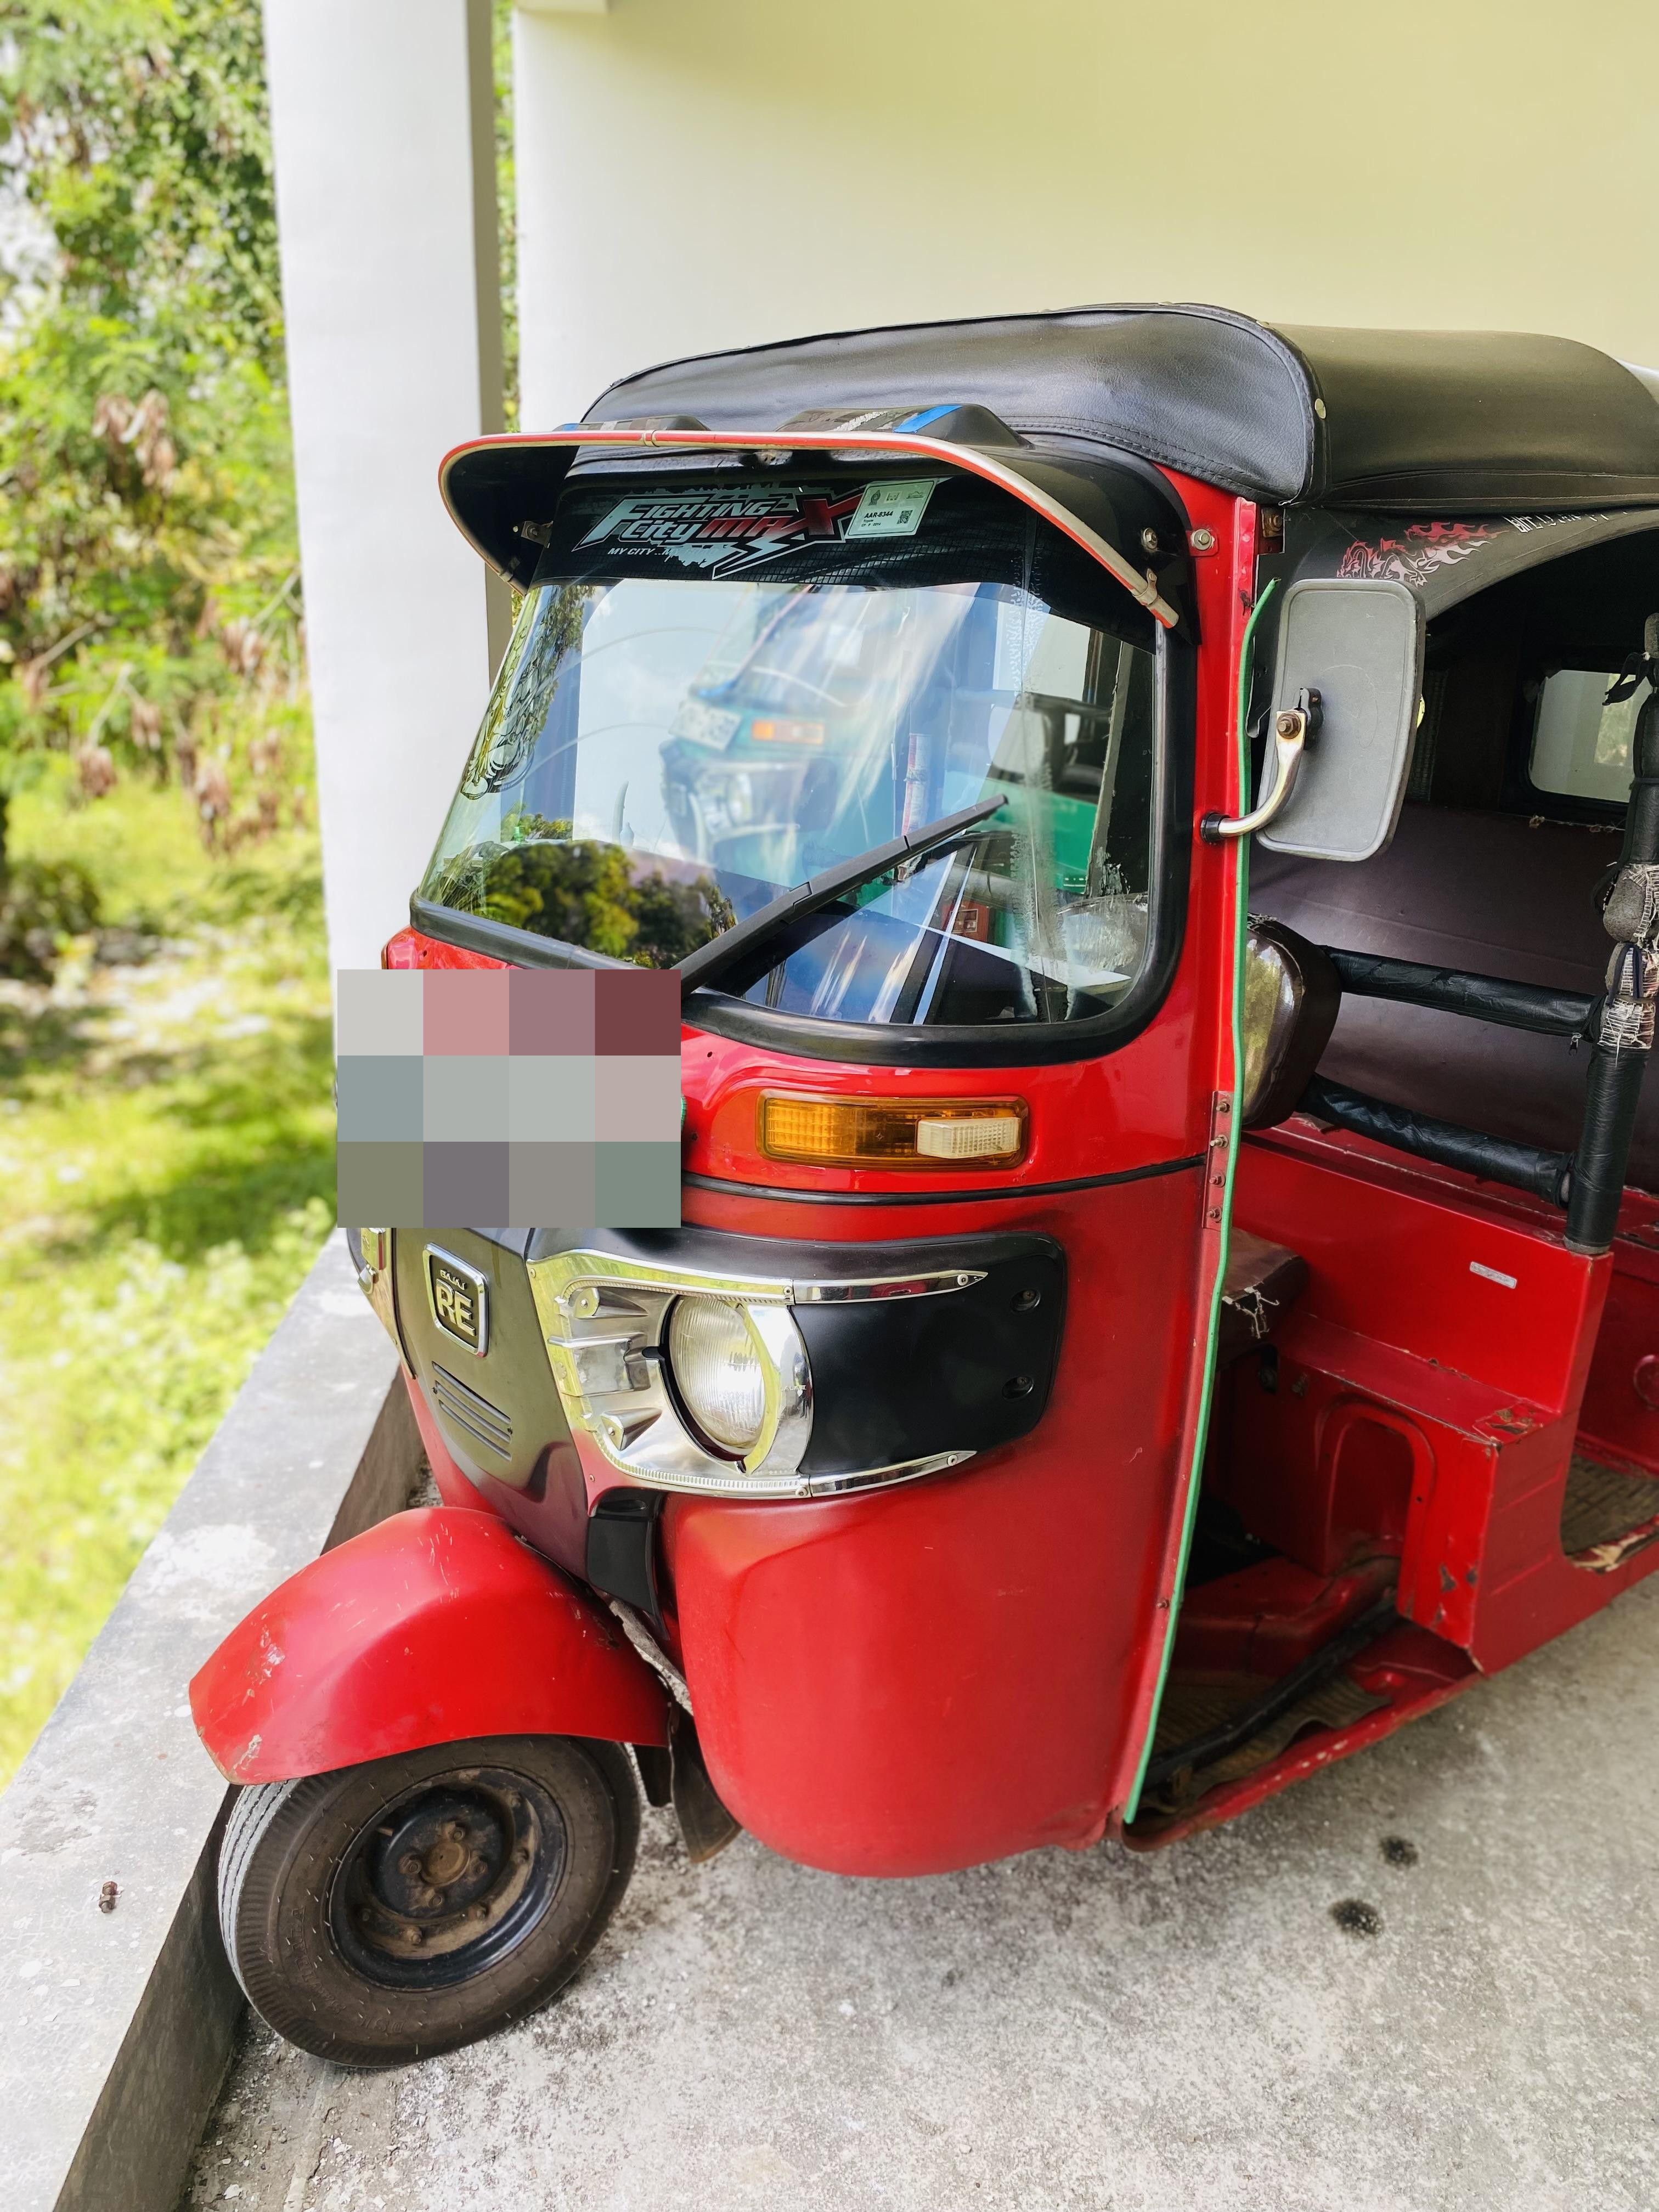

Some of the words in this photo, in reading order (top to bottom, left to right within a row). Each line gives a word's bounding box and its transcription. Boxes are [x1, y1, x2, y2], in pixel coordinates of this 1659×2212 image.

[579, 496, 777, 546] FIGHTING
[440, 1269, 466, 1291] BAJAJ
[436, 1278, 477, 1337] RE
